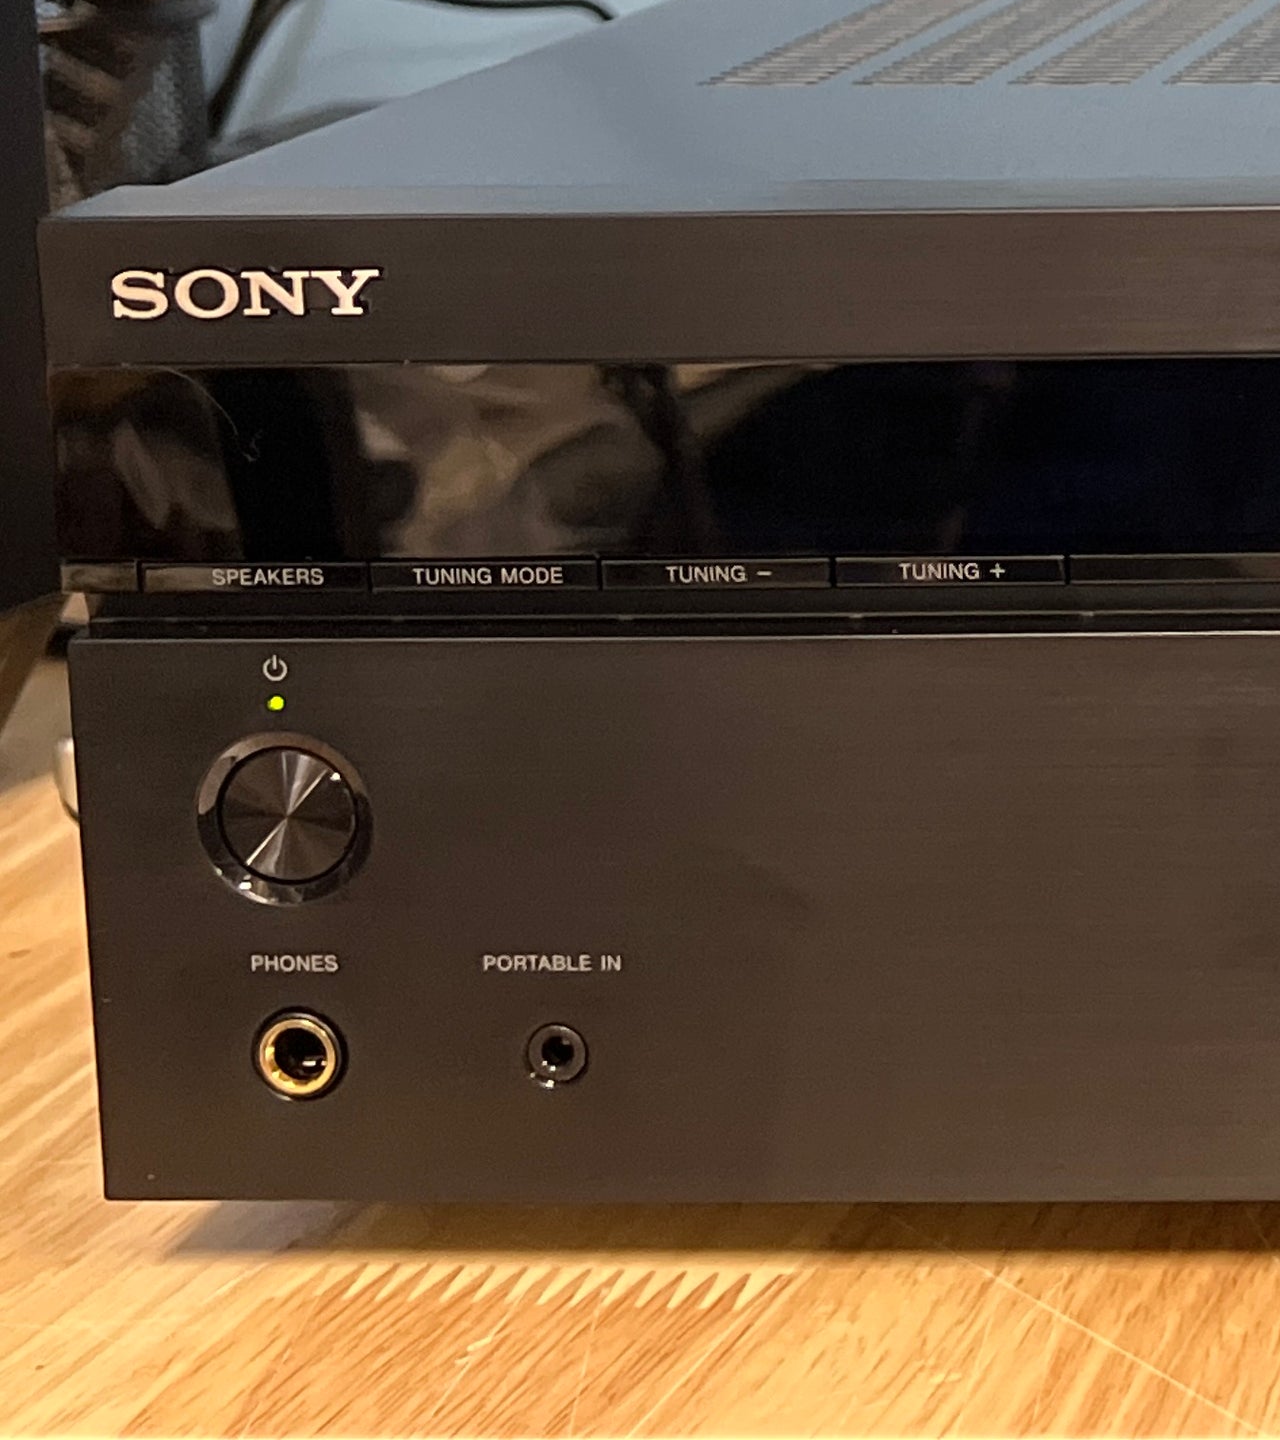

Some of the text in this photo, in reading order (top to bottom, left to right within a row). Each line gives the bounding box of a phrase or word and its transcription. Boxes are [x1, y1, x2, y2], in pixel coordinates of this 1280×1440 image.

[111, 268, 380, 320] SONY
[212, 567, 325, 586] SPEAKERS
[413, 566, 564, 585] TUNING MODE
[666, 565, 747, 583] TUNING
[899, 562, 980, 580] TUNING
[250, 954, 339, 973] PHONES
[482, 954, 622, 973] PORTABLE IN
